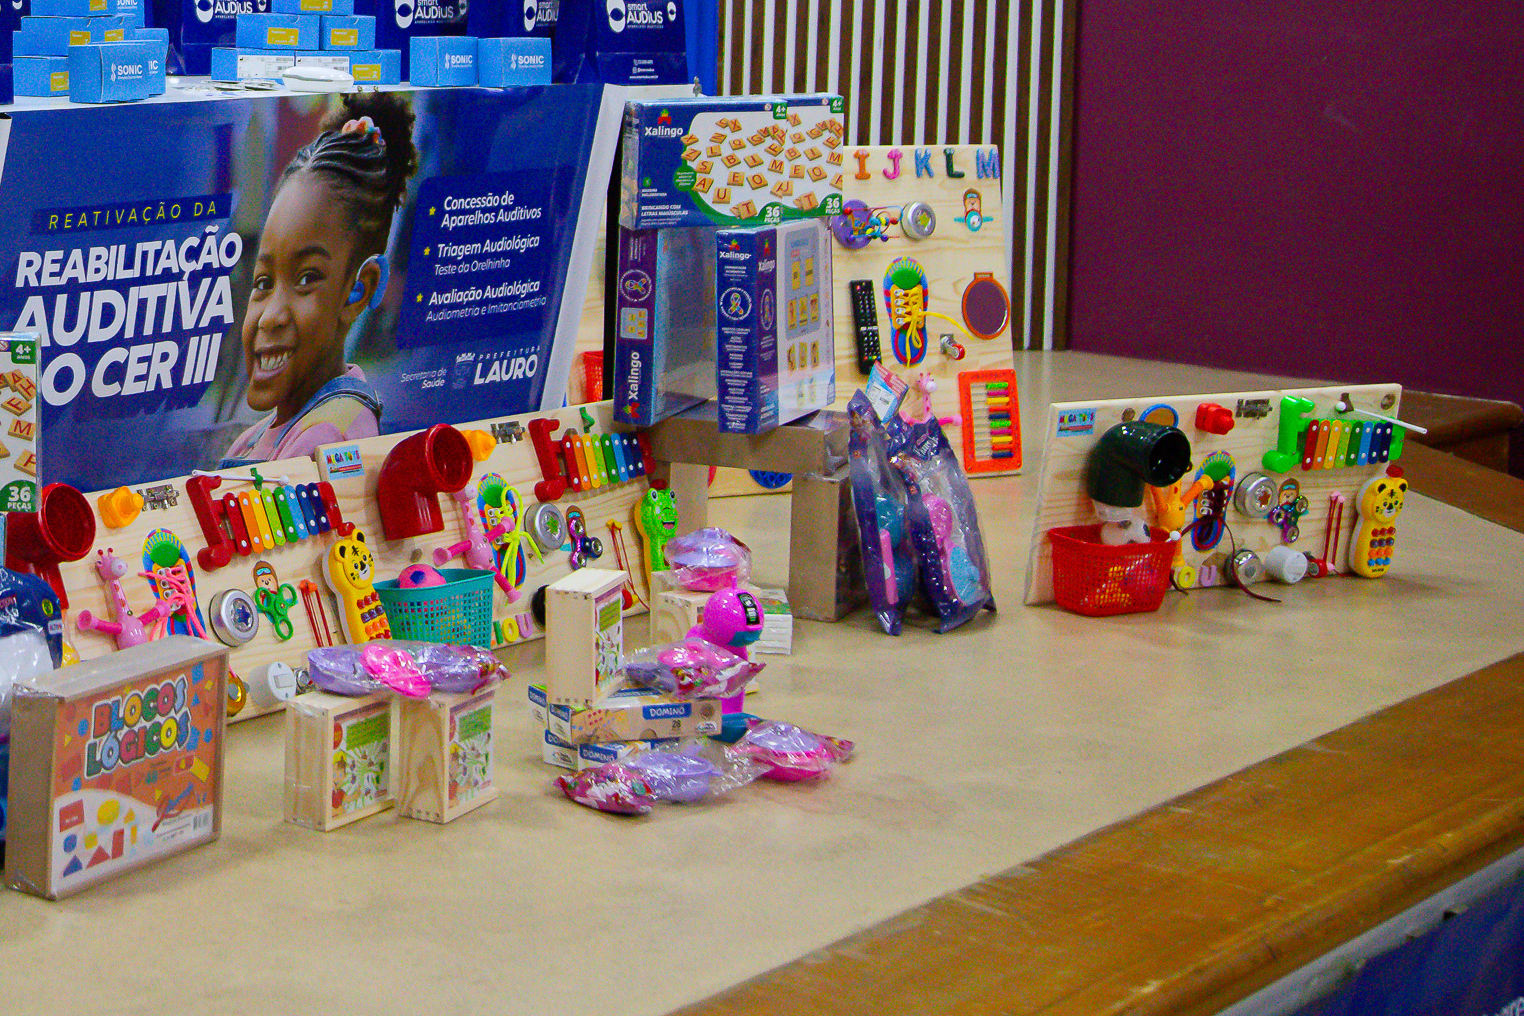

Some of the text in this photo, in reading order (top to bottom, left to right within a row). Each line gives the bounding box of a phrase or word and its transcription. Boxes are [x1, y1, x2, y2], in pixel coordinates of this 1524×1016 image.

[628, 2, 648, 11] smart
[451, 54, 473, 64] SONIC
[518, 55, 544, 65] SONIC
[117, 64, 143, 75] SONIC
[776, 105, 786, 115] 4+
[644, 126, 683, 137] Xalingo
[444, 190, 515, 211] Concessão de
[826, 198, 840, 208] 36
[48, 201, 217, 229] REATIVAÇÃO DA
[441, 205, 542, 231] Aparelhos Auditivos
[765, 206, 780, 218] 36
[437, 233, 540, 260] Triagem Audiológica
[15, 224, 243, 288] REABILITAÇÃO
[719, 251, 752, 260] Xalingo
[435, 257, 510, 276] Teste da Orelhinha
[428, 278, 540, 306] Avaliação Audiológica
[12, 275, 234, 347] AUDITIVA
[425, 305, 479, 322] Audiometria
[481, 306, 487, 315] e
[15, 343, 31, 354] 4+
[478, 345, 541, 361] PREFEITURA
[91, 340, 179, 398] CER
[181, 332, 223, 386] III
[473, 354, 538, 385] LAURO
[400, 367, 448, 383] Secretaria de
[628, 351, 642, 401] Xalingo
[421, 378, 445, 389] Saúde
[8, 486, 31, 502] 36
[7, 501, 32, 512] PEÇAS
[92, 674, 188, 738] BLOCOS
[672, 720, 682, 728] 28
[85, 708, 191, 779] LÓGICOS
